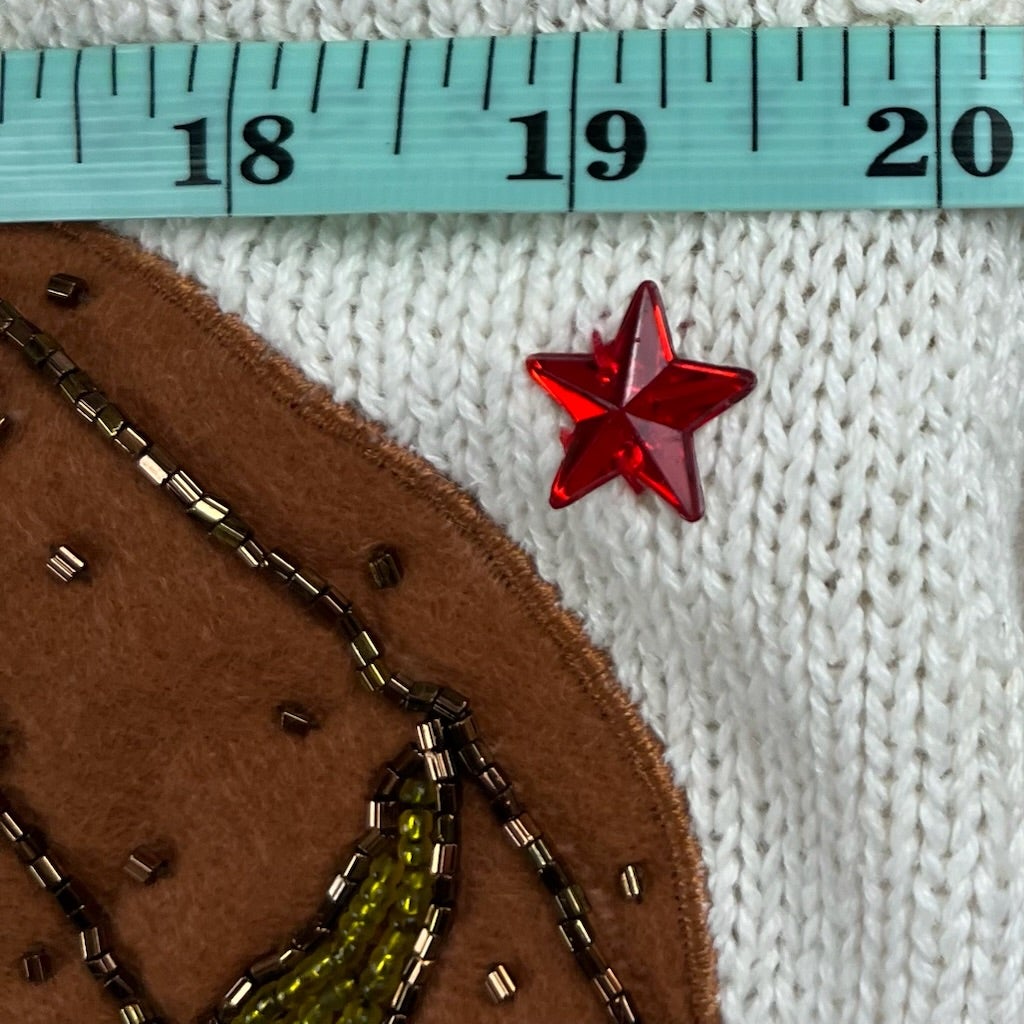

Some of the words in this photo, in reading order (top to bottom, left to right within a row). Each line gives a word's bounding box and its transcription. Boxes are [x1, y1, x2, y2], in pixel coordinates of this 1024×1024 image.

[172, 114, 296, 187] 18
[505, 109, 649, 181] 19
[864, 105, 1015, 178] 20
